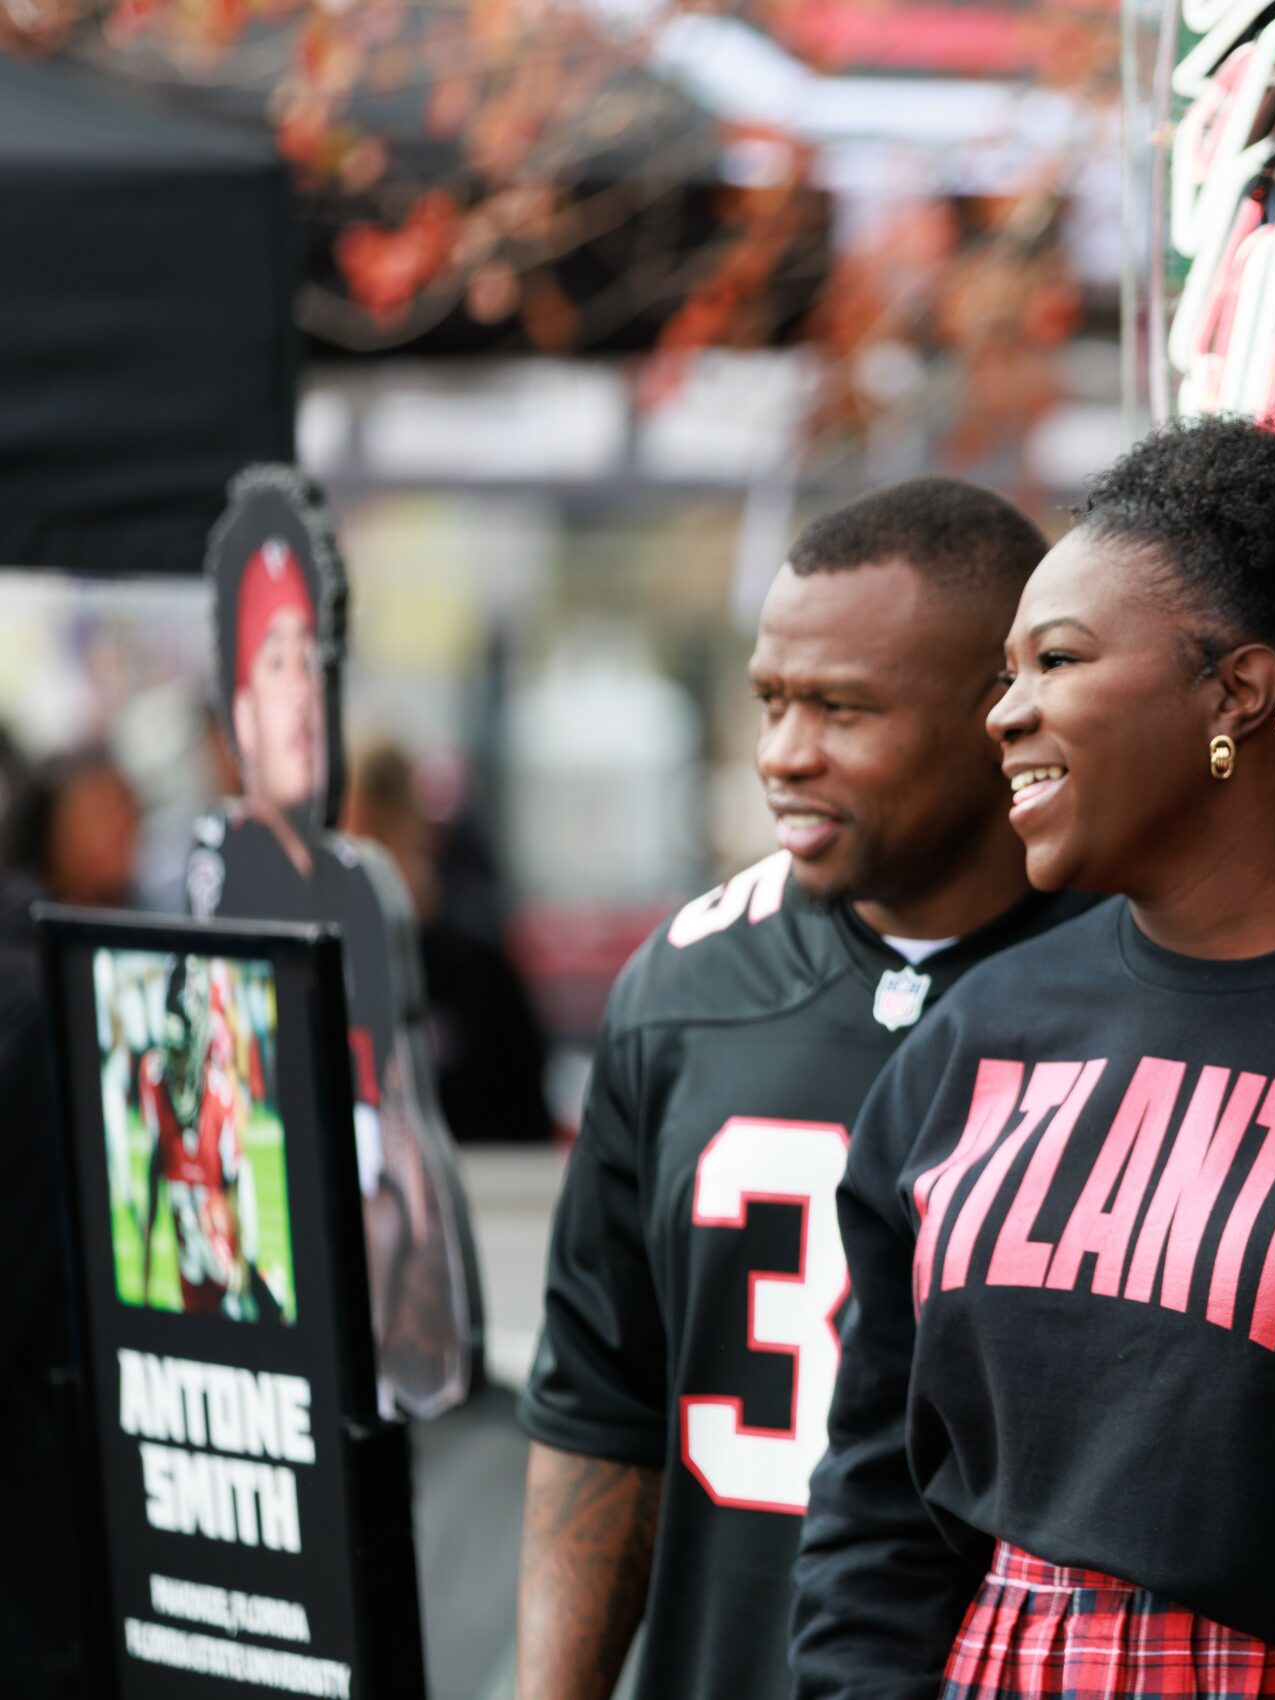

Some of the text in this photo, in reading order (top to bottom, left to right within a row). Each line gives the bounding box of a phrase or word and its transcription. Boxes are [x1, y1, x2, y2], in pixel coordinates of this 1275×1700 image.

[679, 1115, 851, 1516] 3
[117, 1346, 316, 1464] ANTONE
[139, 1440, 301, 1554] SMITH
